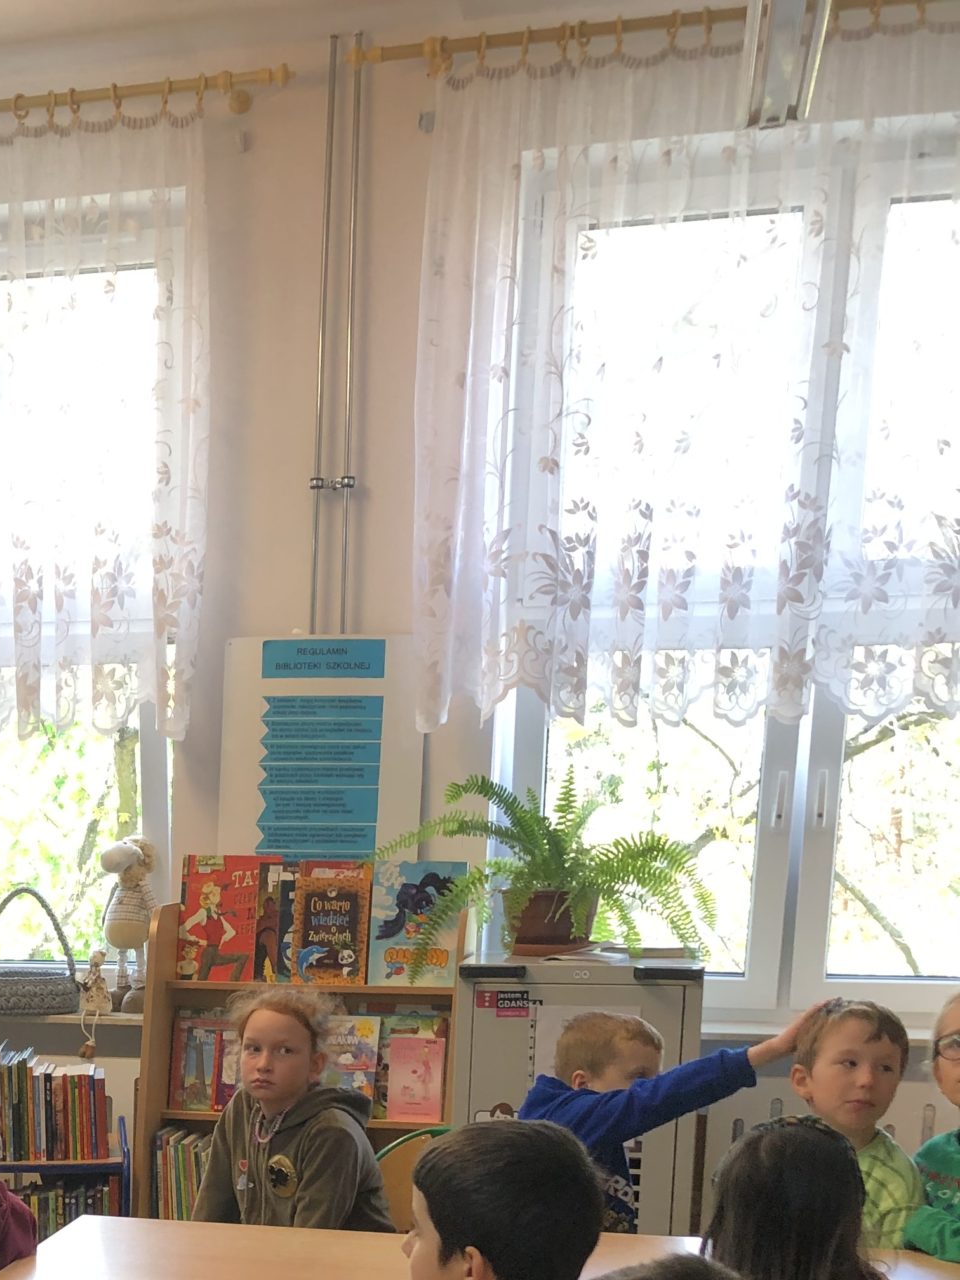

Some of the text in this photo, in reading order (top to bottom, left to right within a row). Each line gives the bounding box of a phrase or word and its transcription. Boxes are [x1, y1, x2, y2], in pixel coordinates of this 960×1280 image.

[296, 647, 348, 656] REGULAMIN
[275, 662, 371, 670] BIBLIOTEKI SZKOLNEJ
[310, 897, 351, 914] Co warto
[311, 911, 350, 927] wiedzieć
